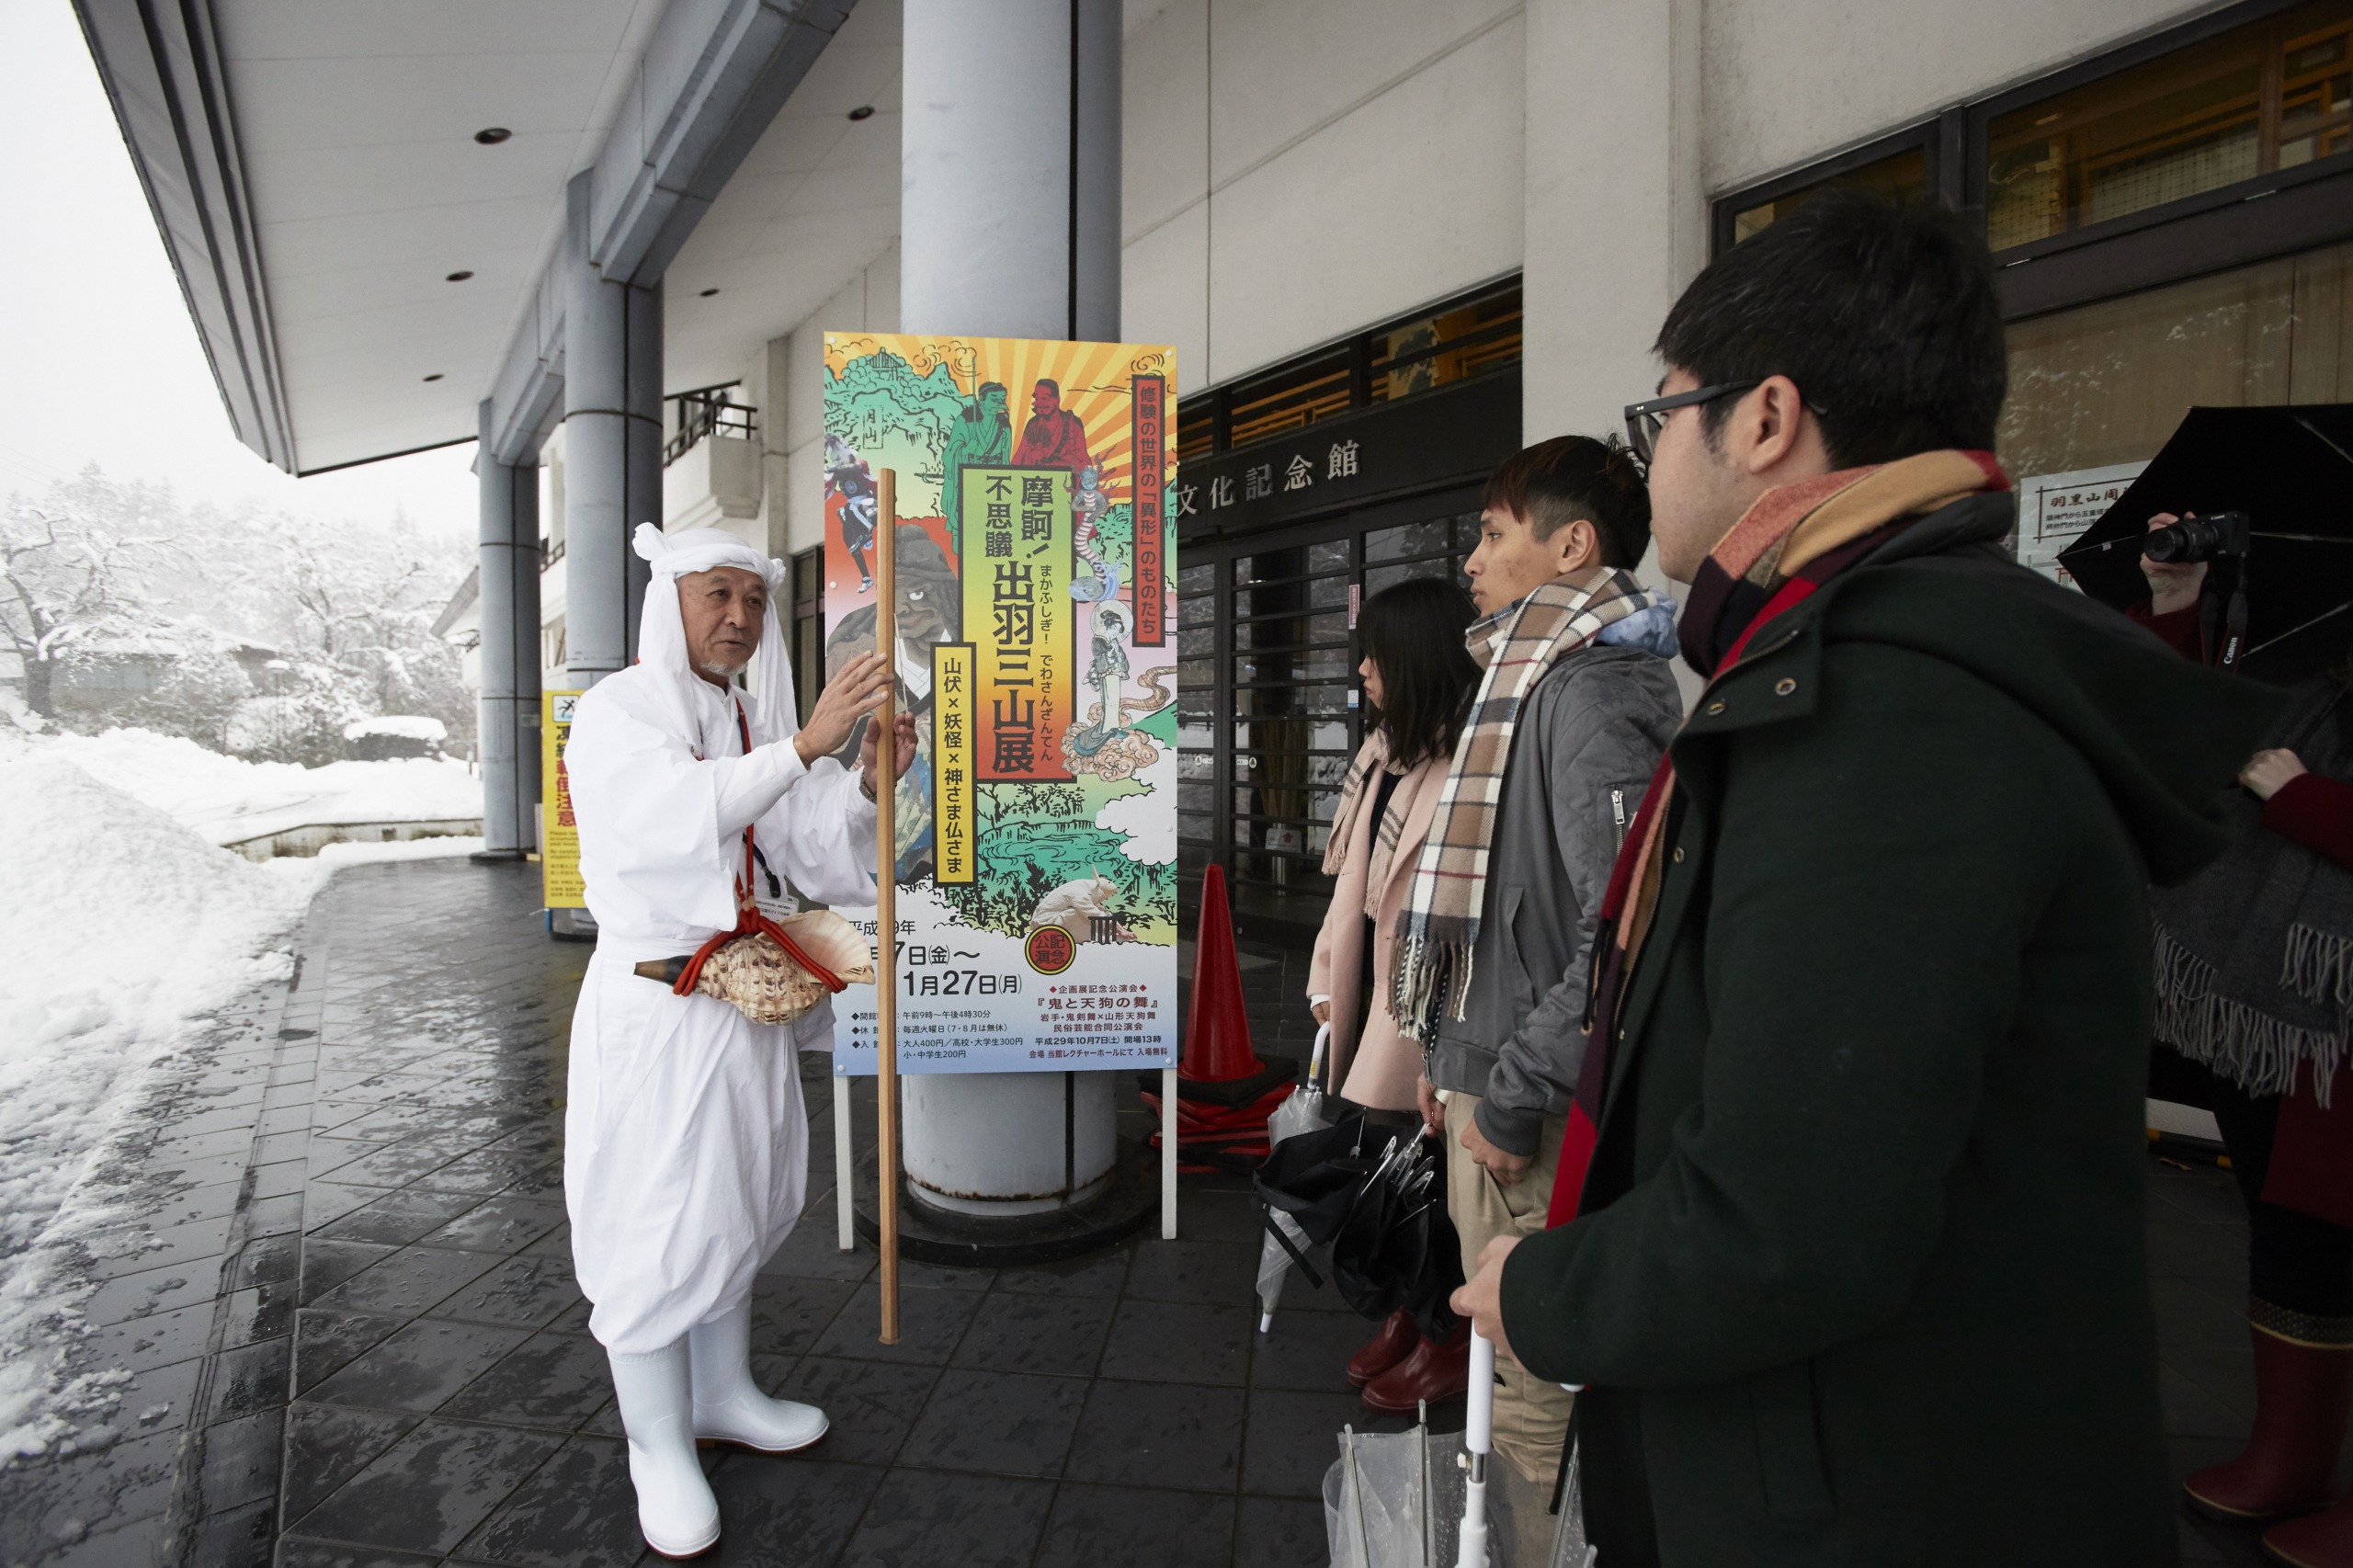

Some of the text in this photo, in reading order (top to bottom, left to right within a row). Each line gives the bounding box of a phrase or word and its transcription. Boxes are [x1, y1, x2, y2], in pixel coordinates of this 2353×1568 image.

[1176, 439, 1361, 517] 文化記念館
[1140, 386, 1157, 634] 修験の世界の「異形」のものたち
[2050, 486, 2129, 508] 羽黒山周
[984, 474, 1013, 558] 不思議
[2223, 637, 2238, 665] Canon
[992, 560, 1036, 774] 出羽三山展
[1040, 653, 1053, 762] でわさんざんてん
[859, 1012, 878, 1021] 開館
[1037, 996, 1158, 1010] 『鬼と天狗の舞』
[1052, 1022, 1143, 1033] 民俗芸能合同公演会
[1029, 1047, 1168, 1059] 会場 当館レクチャーホールにて 入場無料
